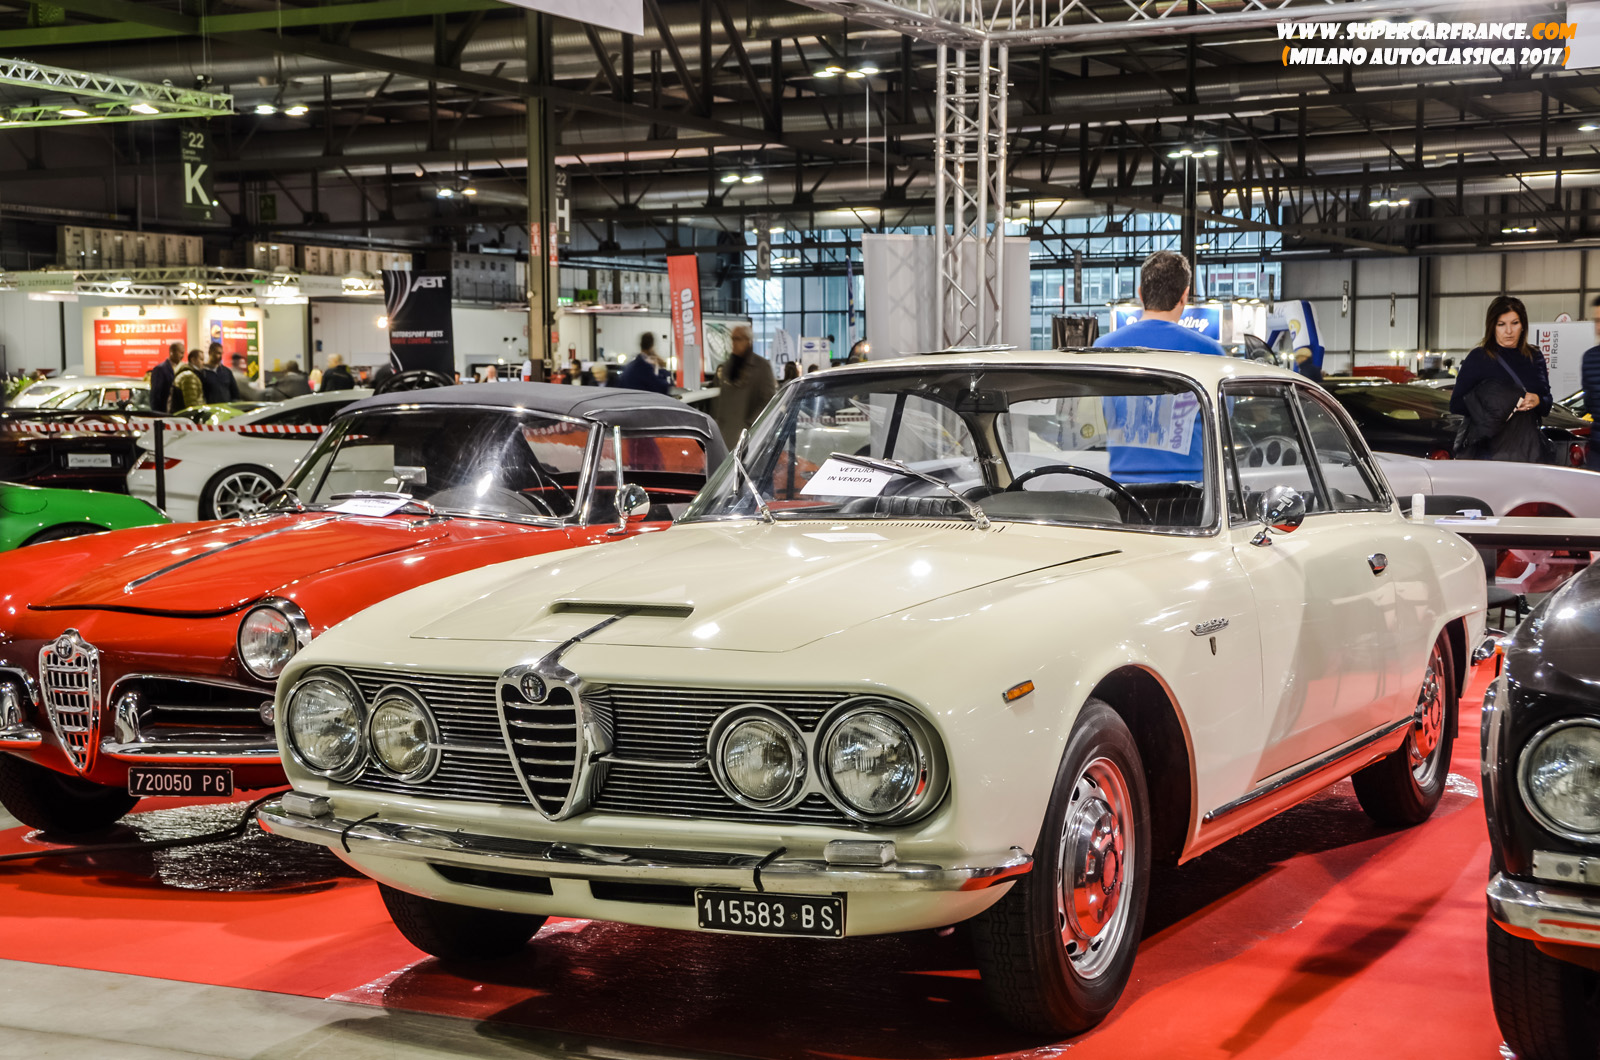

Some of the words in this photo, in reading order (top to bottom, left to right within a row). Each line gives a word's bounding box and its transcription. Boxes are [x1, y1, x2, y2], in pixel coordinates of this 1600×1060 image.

[188, 132, 204, 148] 22
[184, 162, 211, 205] K
[556, 172, 567, 186] 22
[555, 198, 570, 232] H
[757, 240, 770, 270] G
[410, 276, 446, 292] ABT
[1341, 294, 1348, 312] B
[1550, 330, 1559, 355] Rossi
[136, 773, 192, 791] 720050
[704, 898, 785, 927] 115583
